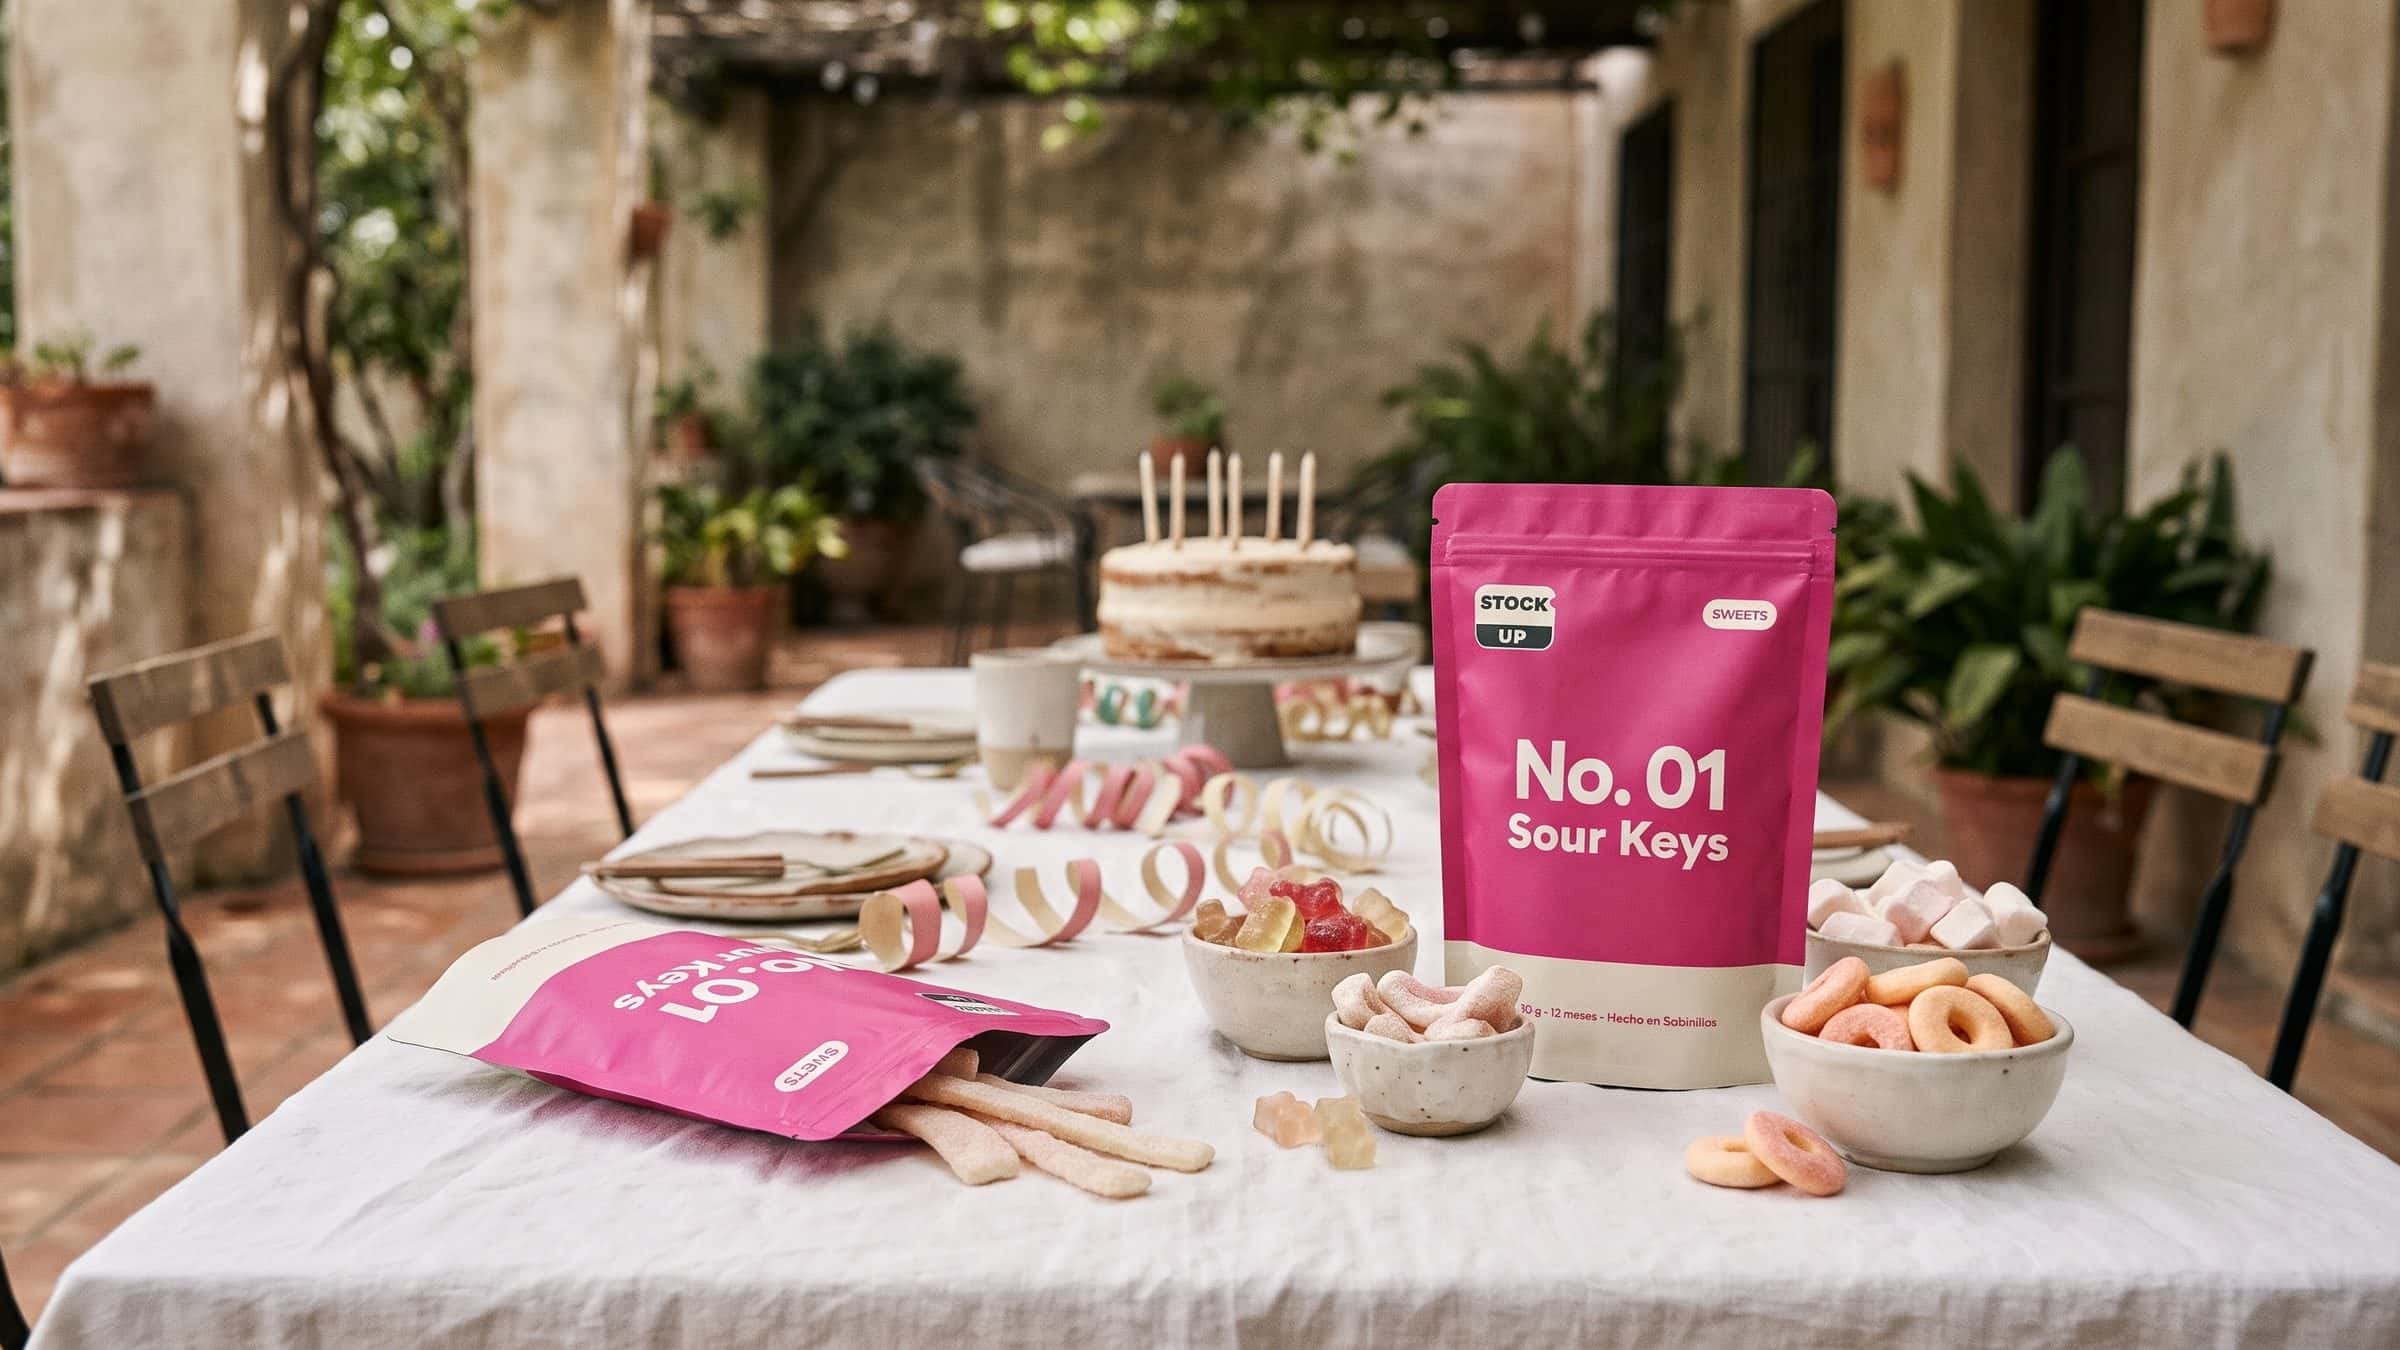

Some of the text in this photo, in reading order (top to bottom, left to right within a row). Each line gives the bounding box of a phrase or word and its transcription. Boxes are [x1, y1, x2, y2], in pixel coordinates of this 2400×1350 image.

[1480, 595, 1549, 612] STOCK
[1712, 608, 1768, 621] SWEETS
[1498, 628, 1526, 644] UP
[1516, 739, 1726, 811] No. 01
[1508, 812, 1729, 870] Sour Keys
[613, 960, 726, 1010] Keys
[659, 978, 760, 1024] 01
[1551, 1007, 1561, 1018] 12
[1563, 1011, 1598, 1021] meses
[1607, 1012, 1644, 1025] Hecho
[1646, 1017, 1661, 1026] en
